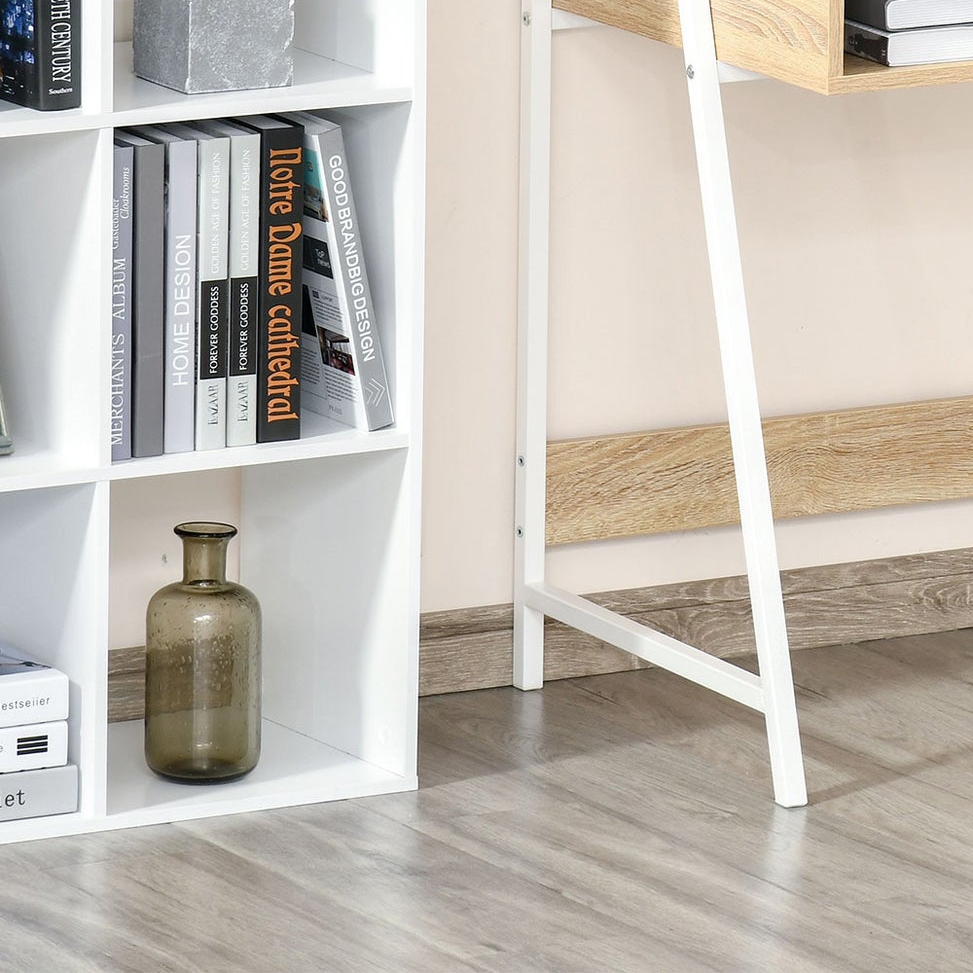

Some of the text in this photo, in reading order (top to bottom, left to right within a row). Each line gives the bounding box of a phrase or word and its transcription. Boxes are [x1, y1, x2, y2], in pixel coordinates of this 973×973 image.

[51, 22, 72, 82] CENTURY
[119, 167, 130, 219] Cloakrooms
[210, 152, 221, 274] GOLDEN AGE OF FASHION
[240, 149, 250, 271] GOLDEN AGE OF FASHION
[239, 283, 249, 371] FOREVER GODDESS
[267, 147, 303, 423] Notre Dame cathedral
[111, 257, 126, 445] MERCHANTS ALBUM
[172, 322, 190, 387] HOME
[209, 286, 220, 374] FOREVER GODDESS
